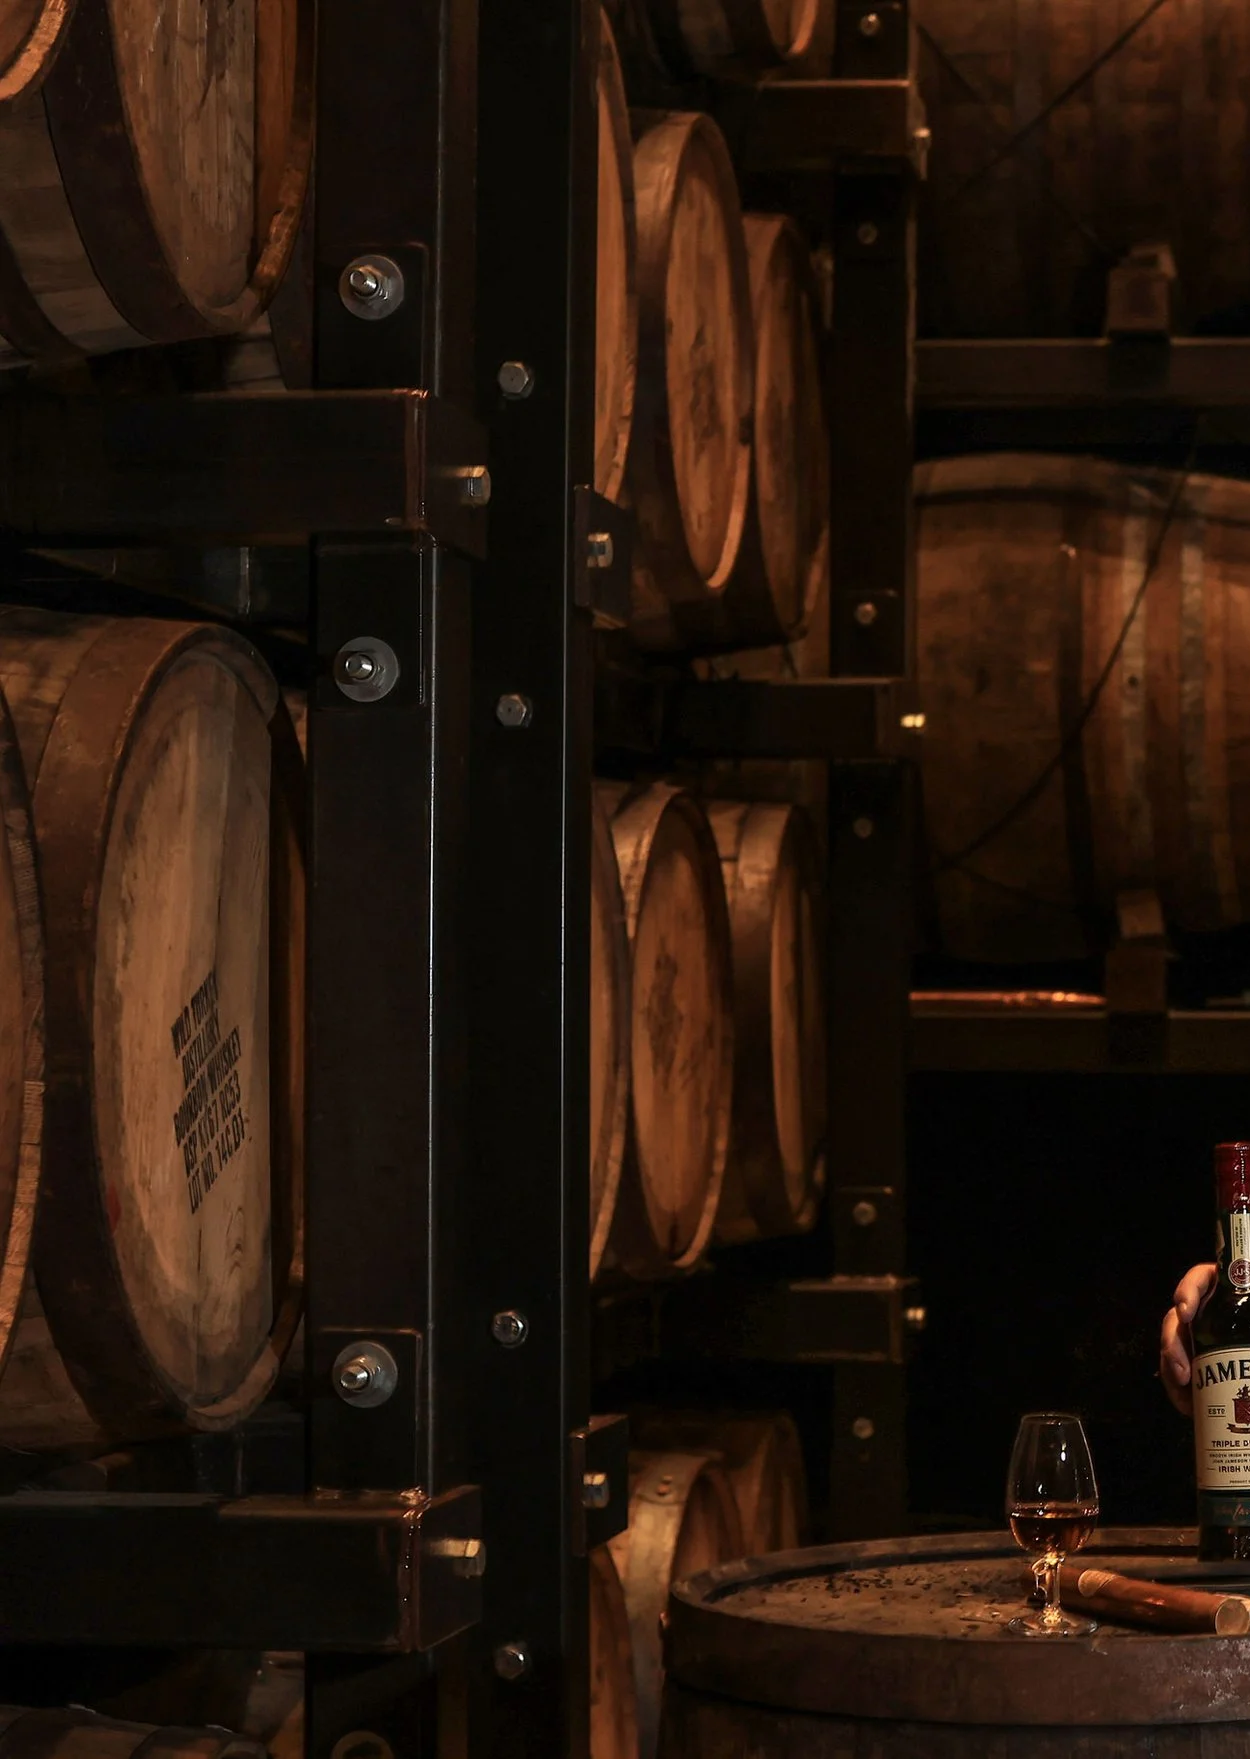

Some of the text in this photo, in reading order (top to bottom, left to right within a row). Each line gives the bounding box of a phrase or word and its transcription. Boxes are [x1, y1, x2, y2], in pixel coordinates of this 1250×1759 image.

[171, 1006, 192, 1060] WILD
[182, 1008, 220, 1089] DISTILLERY
[207, 1026, 242, 1094] WHISKEY
[188, 1168, 202, 1214] LOT
[1212, 1440, 1240, 1448] TRIPLE
